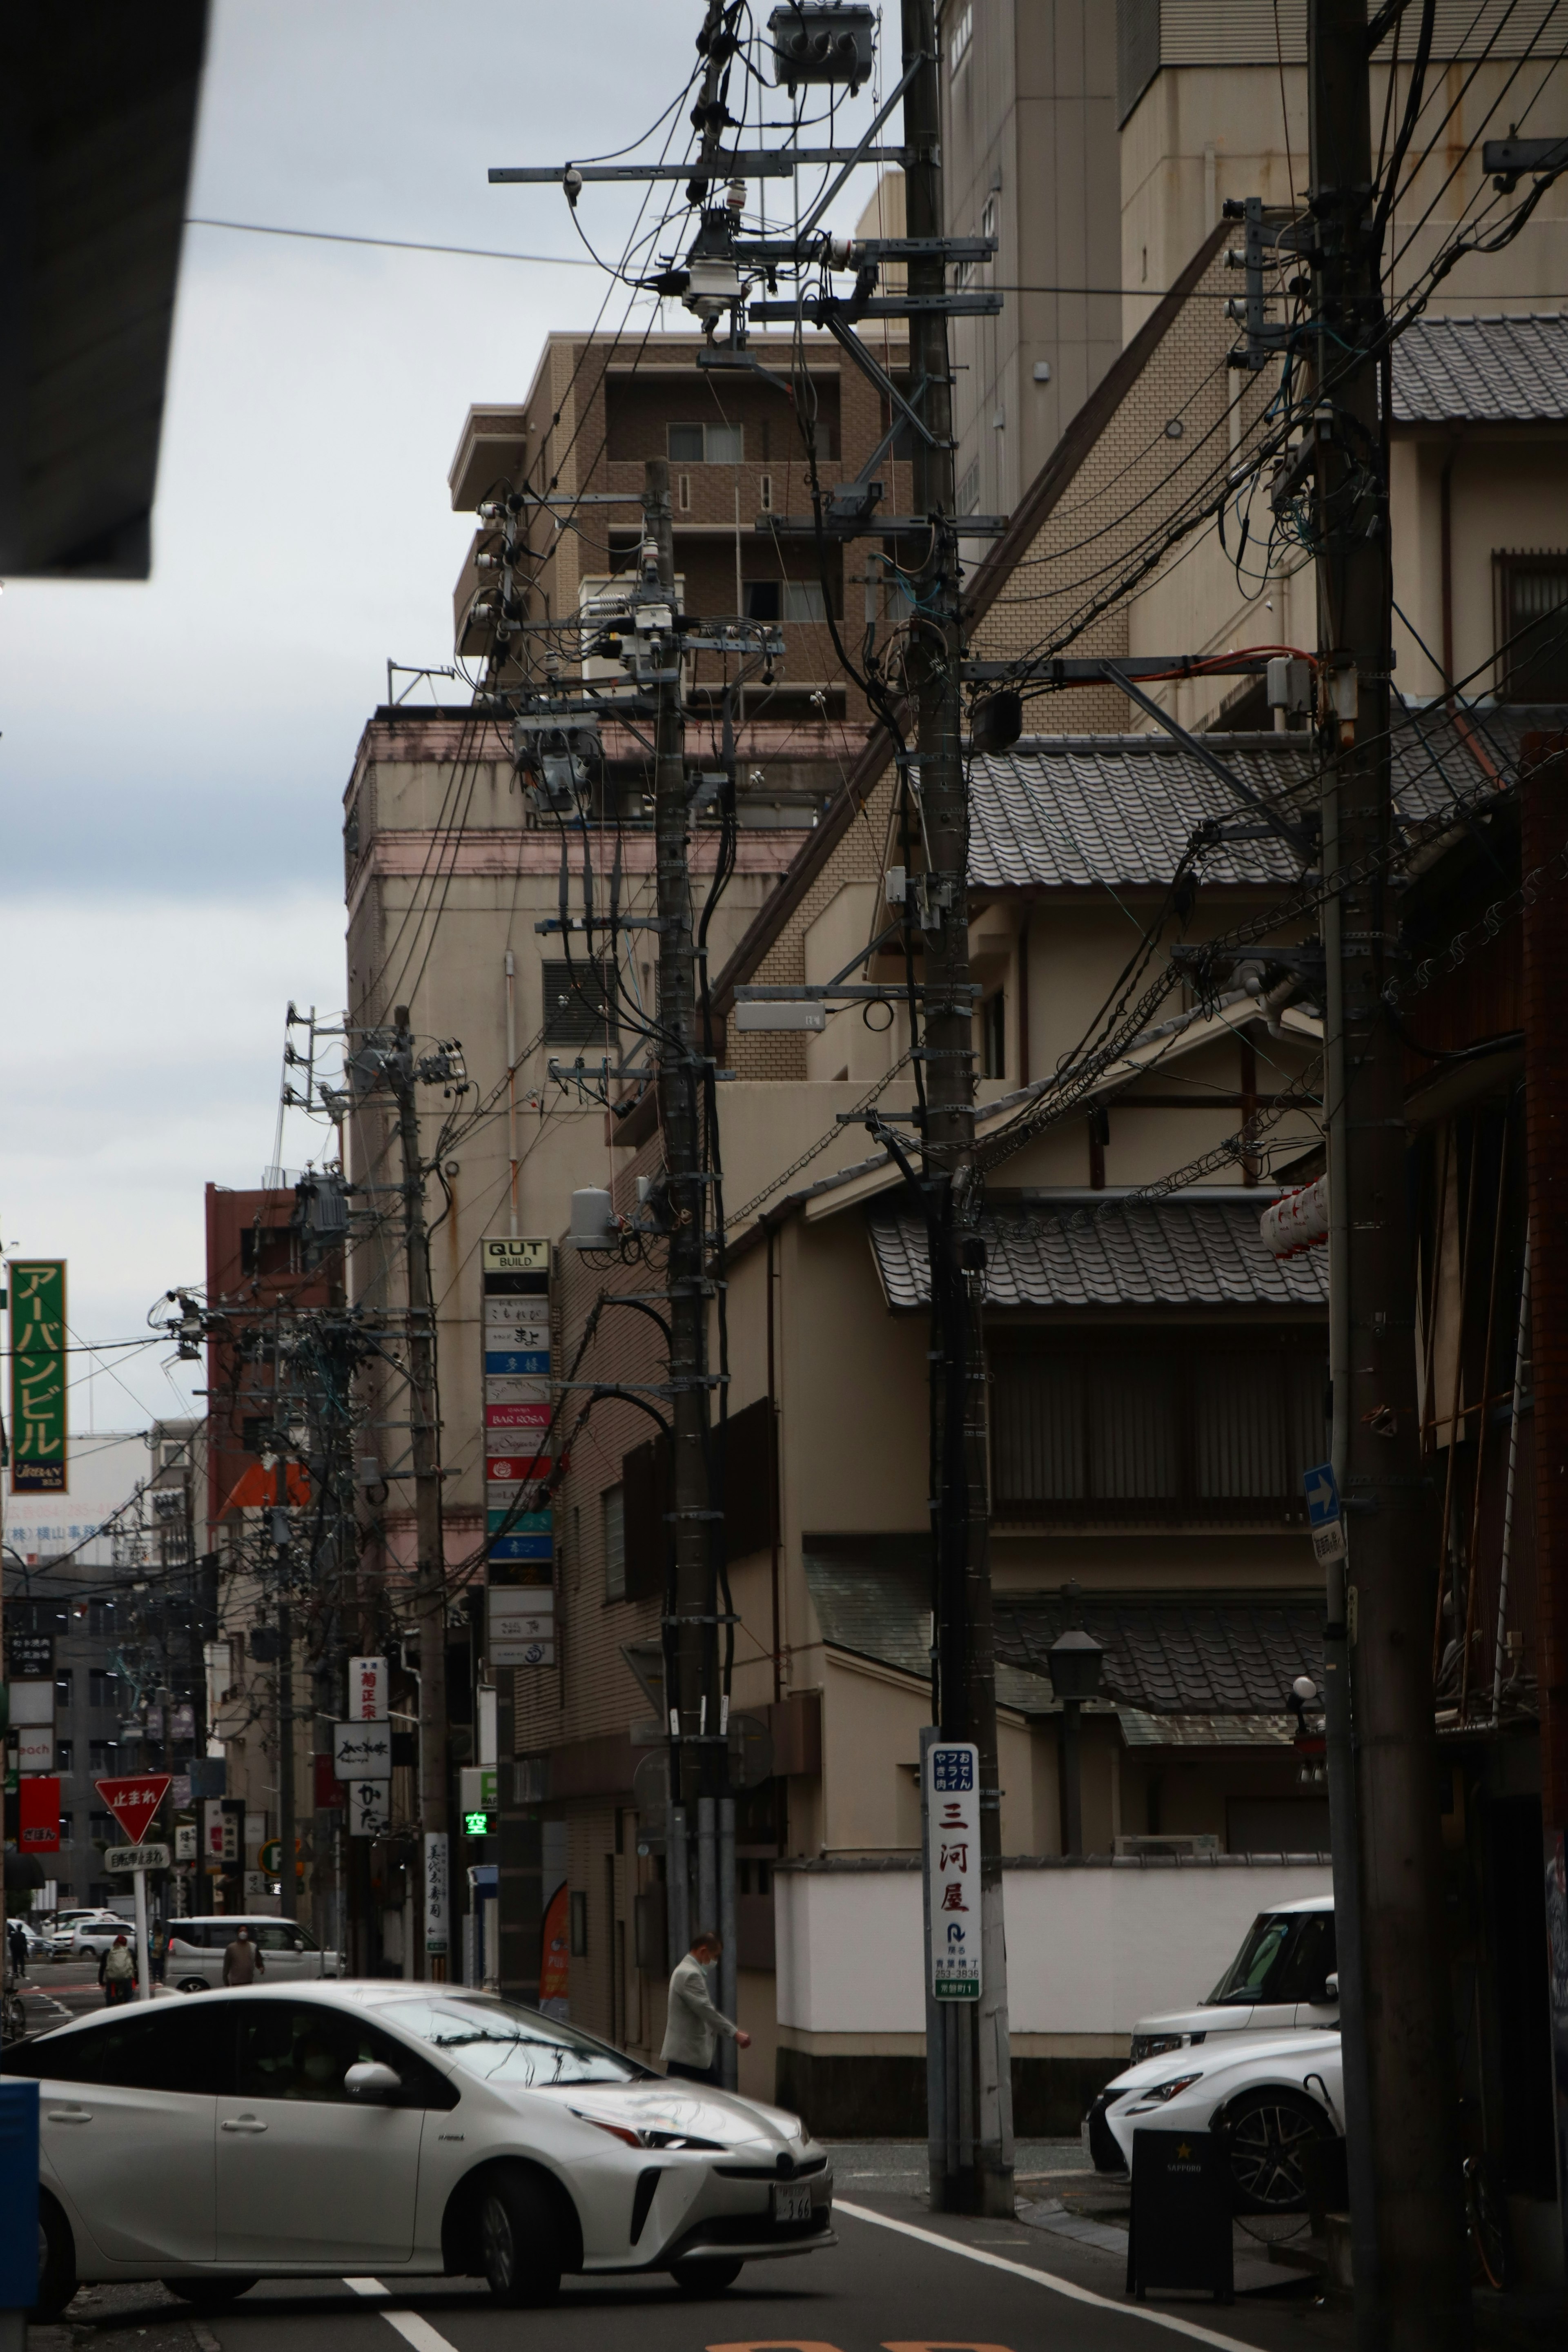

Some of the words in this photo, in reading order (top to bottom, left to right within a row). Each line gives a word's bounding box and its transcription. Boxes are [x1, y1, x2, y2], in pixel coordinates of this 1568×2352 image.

[499, 1257, 532, 1266] BUILD
[492, 1307, 541, 1321] こもれび
[514, 1327, 539, 1345] まよ
[16, 1267, 60, 1455] アーバンビル
[492, 1415, 514, 1424] BAR
[516, 1415, 545, 1424] ROSA
[361, 1672, 376, 1719] 菊正宗
[935, 1753, 946, 1789] やき肉
[948, 1753, 958, 1789] フライ
[960, 1753, 971, 1789] おでん
[112, 1788, 158, 1807] 止まれ
[465, 1811, 488, 1835] 空
[111, 1849, 163, 1868] 自転車止まれ
[940, 1803, 969, 1913] 三河屋
[935, 1969, 979, 1978] 253-3836
[1167, 2164, 1201, 2173] SAPPORO
